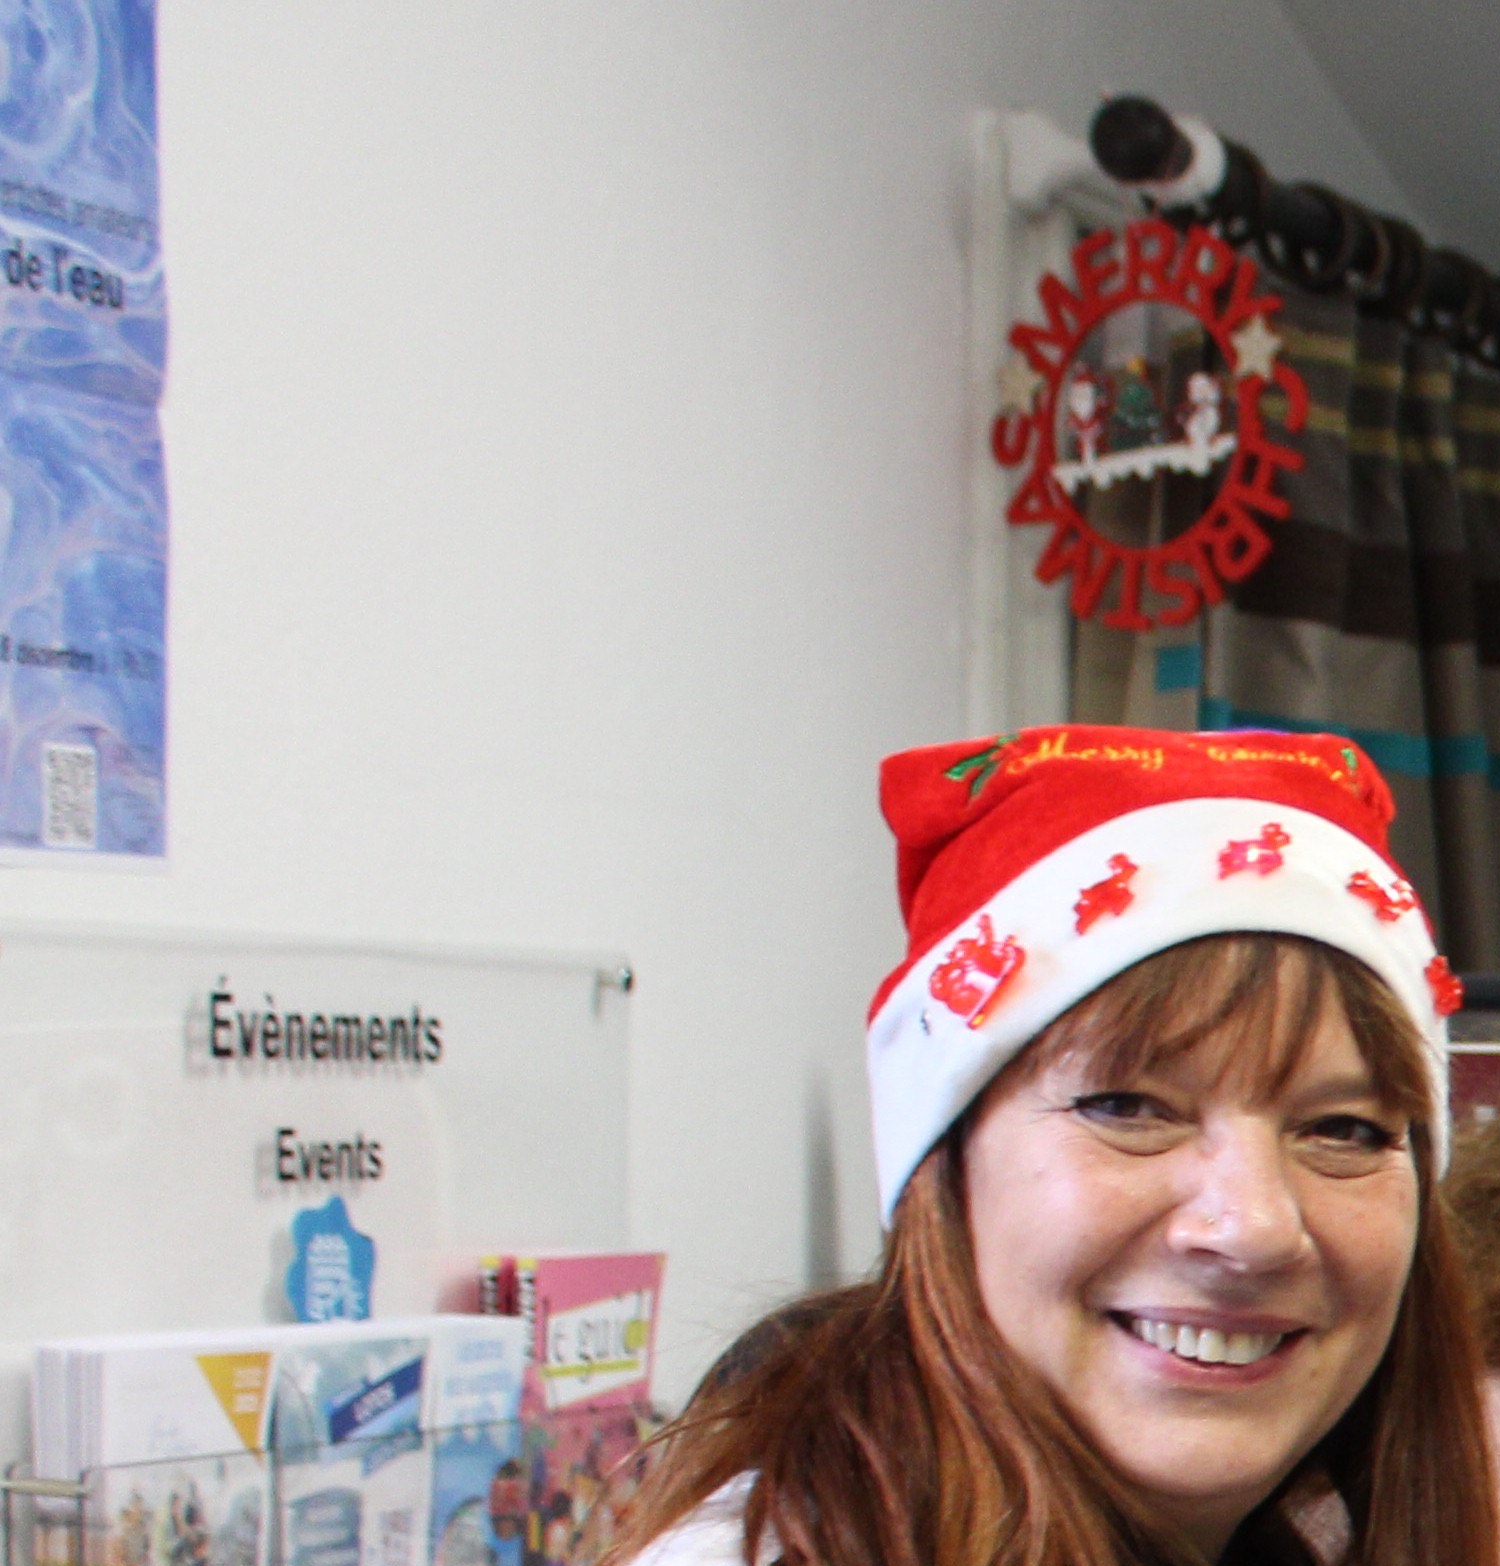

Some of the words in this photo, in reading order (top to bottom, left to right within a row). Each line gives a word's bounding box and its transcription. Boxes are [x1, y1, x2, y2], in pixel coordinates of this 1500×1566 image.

[7, 236, 42, 291] de
[1007, 218, 1285, 376] MERRY
[991, 362, 1310, 632] CHRISTMAS
[210, 974, 441, 1063] Évènements
[276, 1127, 385, 1181] Events
